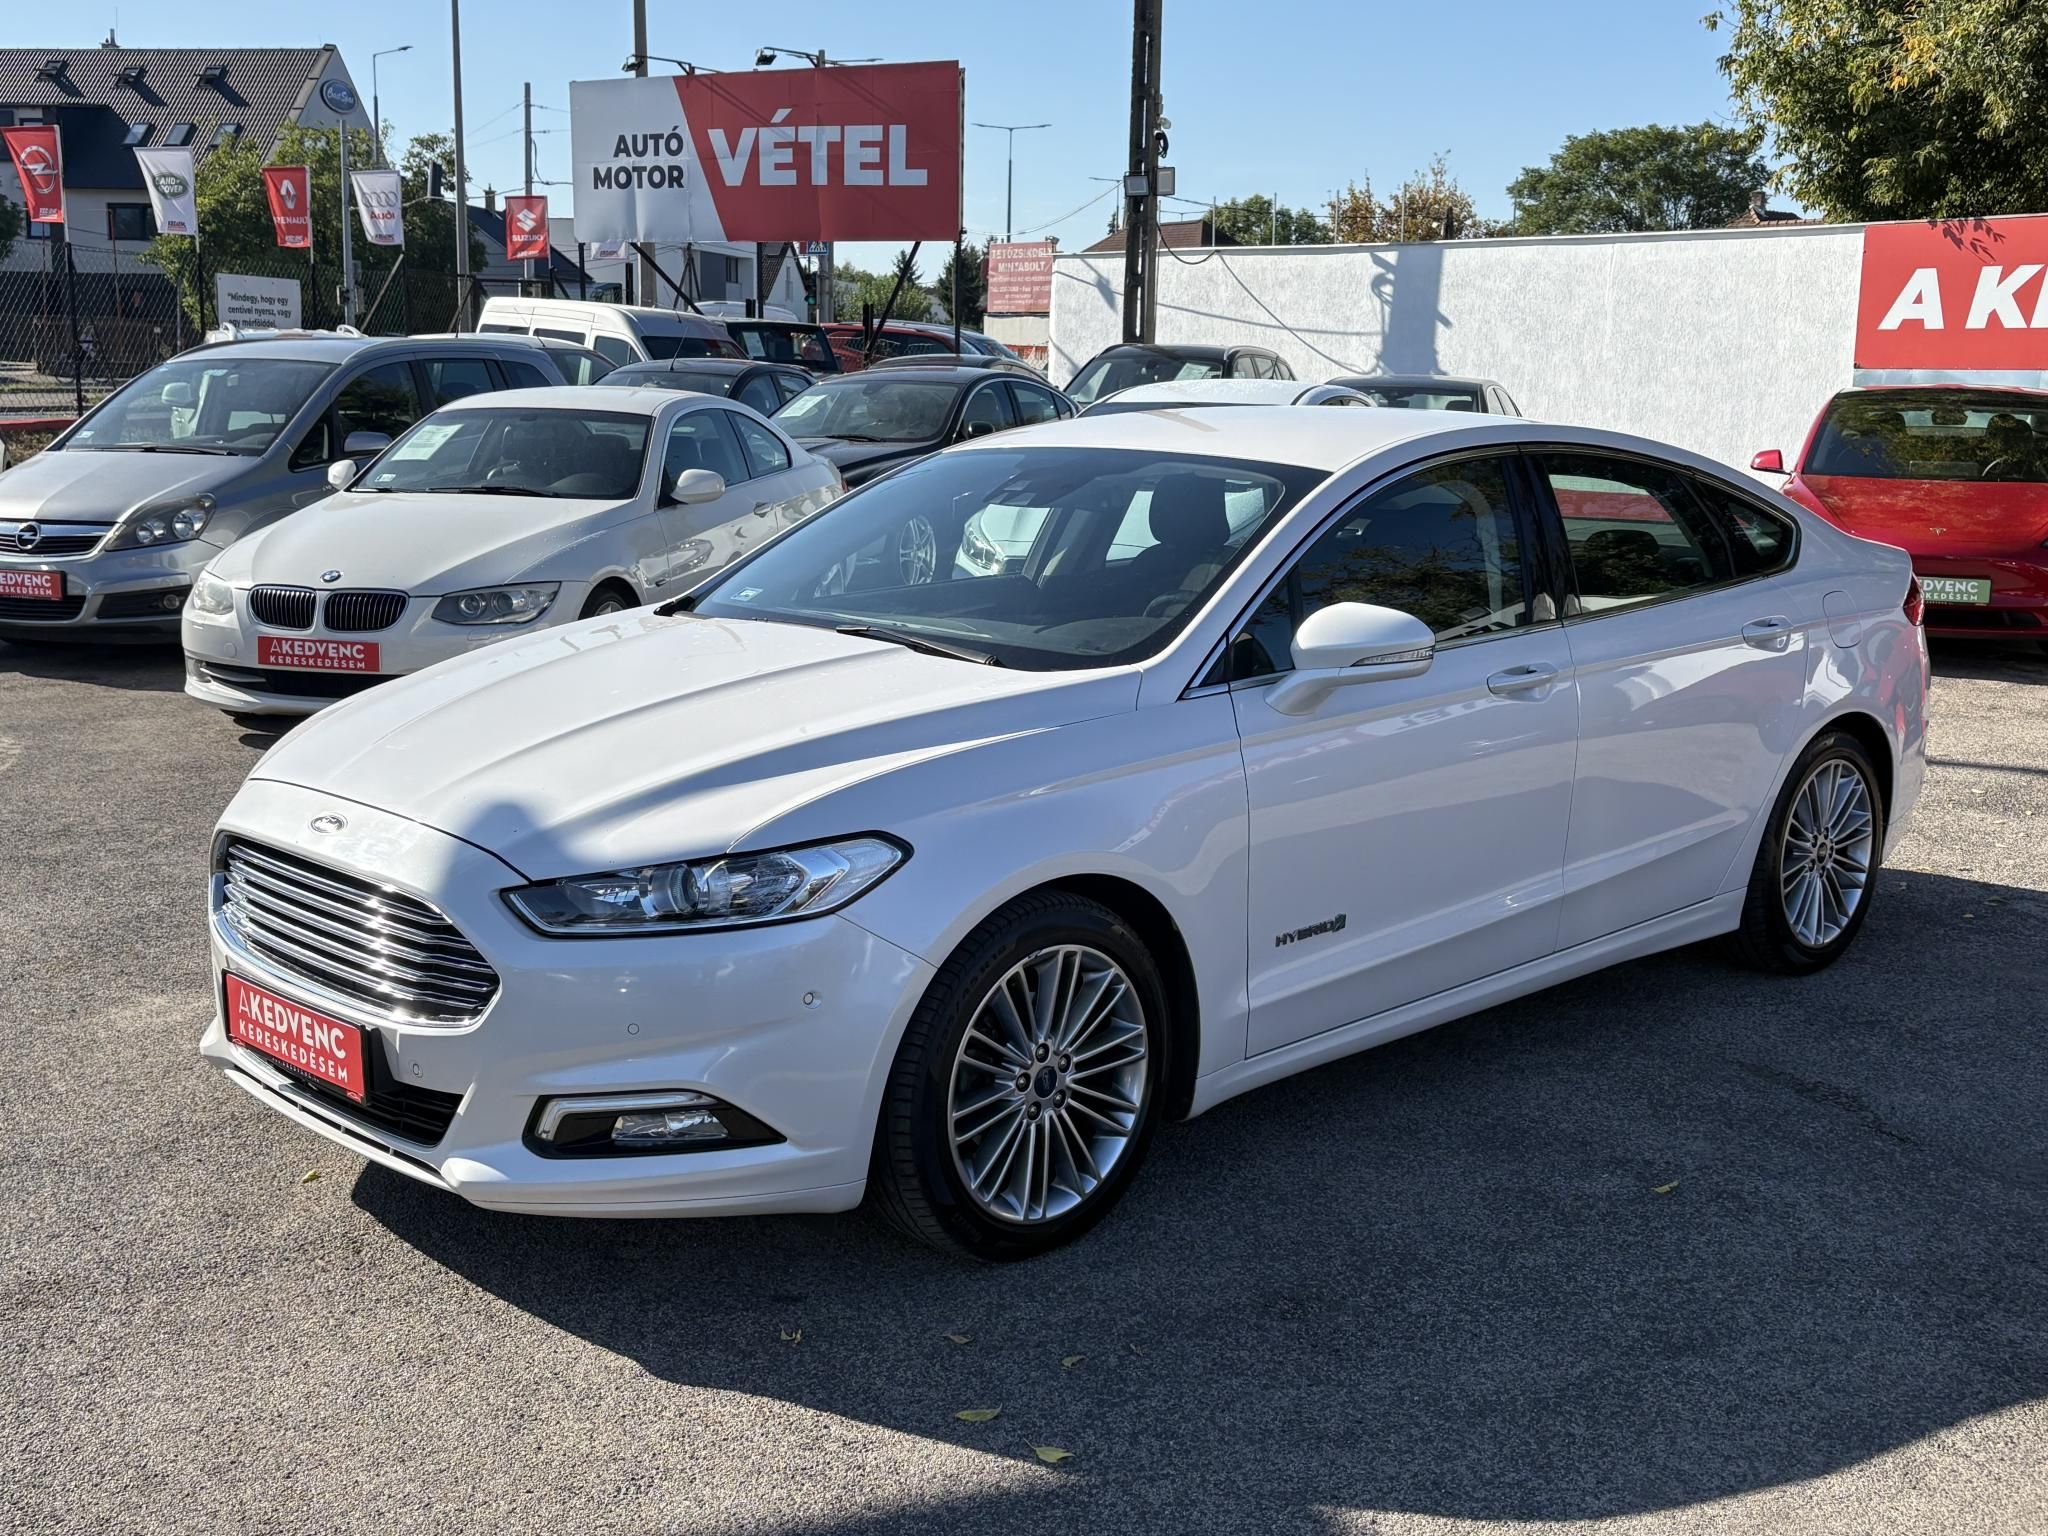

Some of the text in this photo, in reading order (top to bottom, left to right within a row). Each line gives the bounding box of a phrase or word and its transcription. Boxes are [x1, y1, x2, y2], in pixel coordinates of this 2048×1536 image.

[613, 125, 684, 158] AUTÓ
[707, 108, 928, 187] VÉTEL
[592, 165, 685, 190] MOTOR
[512, 234, 543, 242] SUZUKI
[260, 294, 276, 306] hogy
[277, 297, 289, 307] egy
[1877, 267, 1945, 330] A
[277, 310, 292, 319] vagy
[269, 655, 366, 670] KERESKEDÉSEM
[1275, 919, 1335, 948] HYBRID
[239, 1018, 348, 1084] KERESKEDÉSEM
